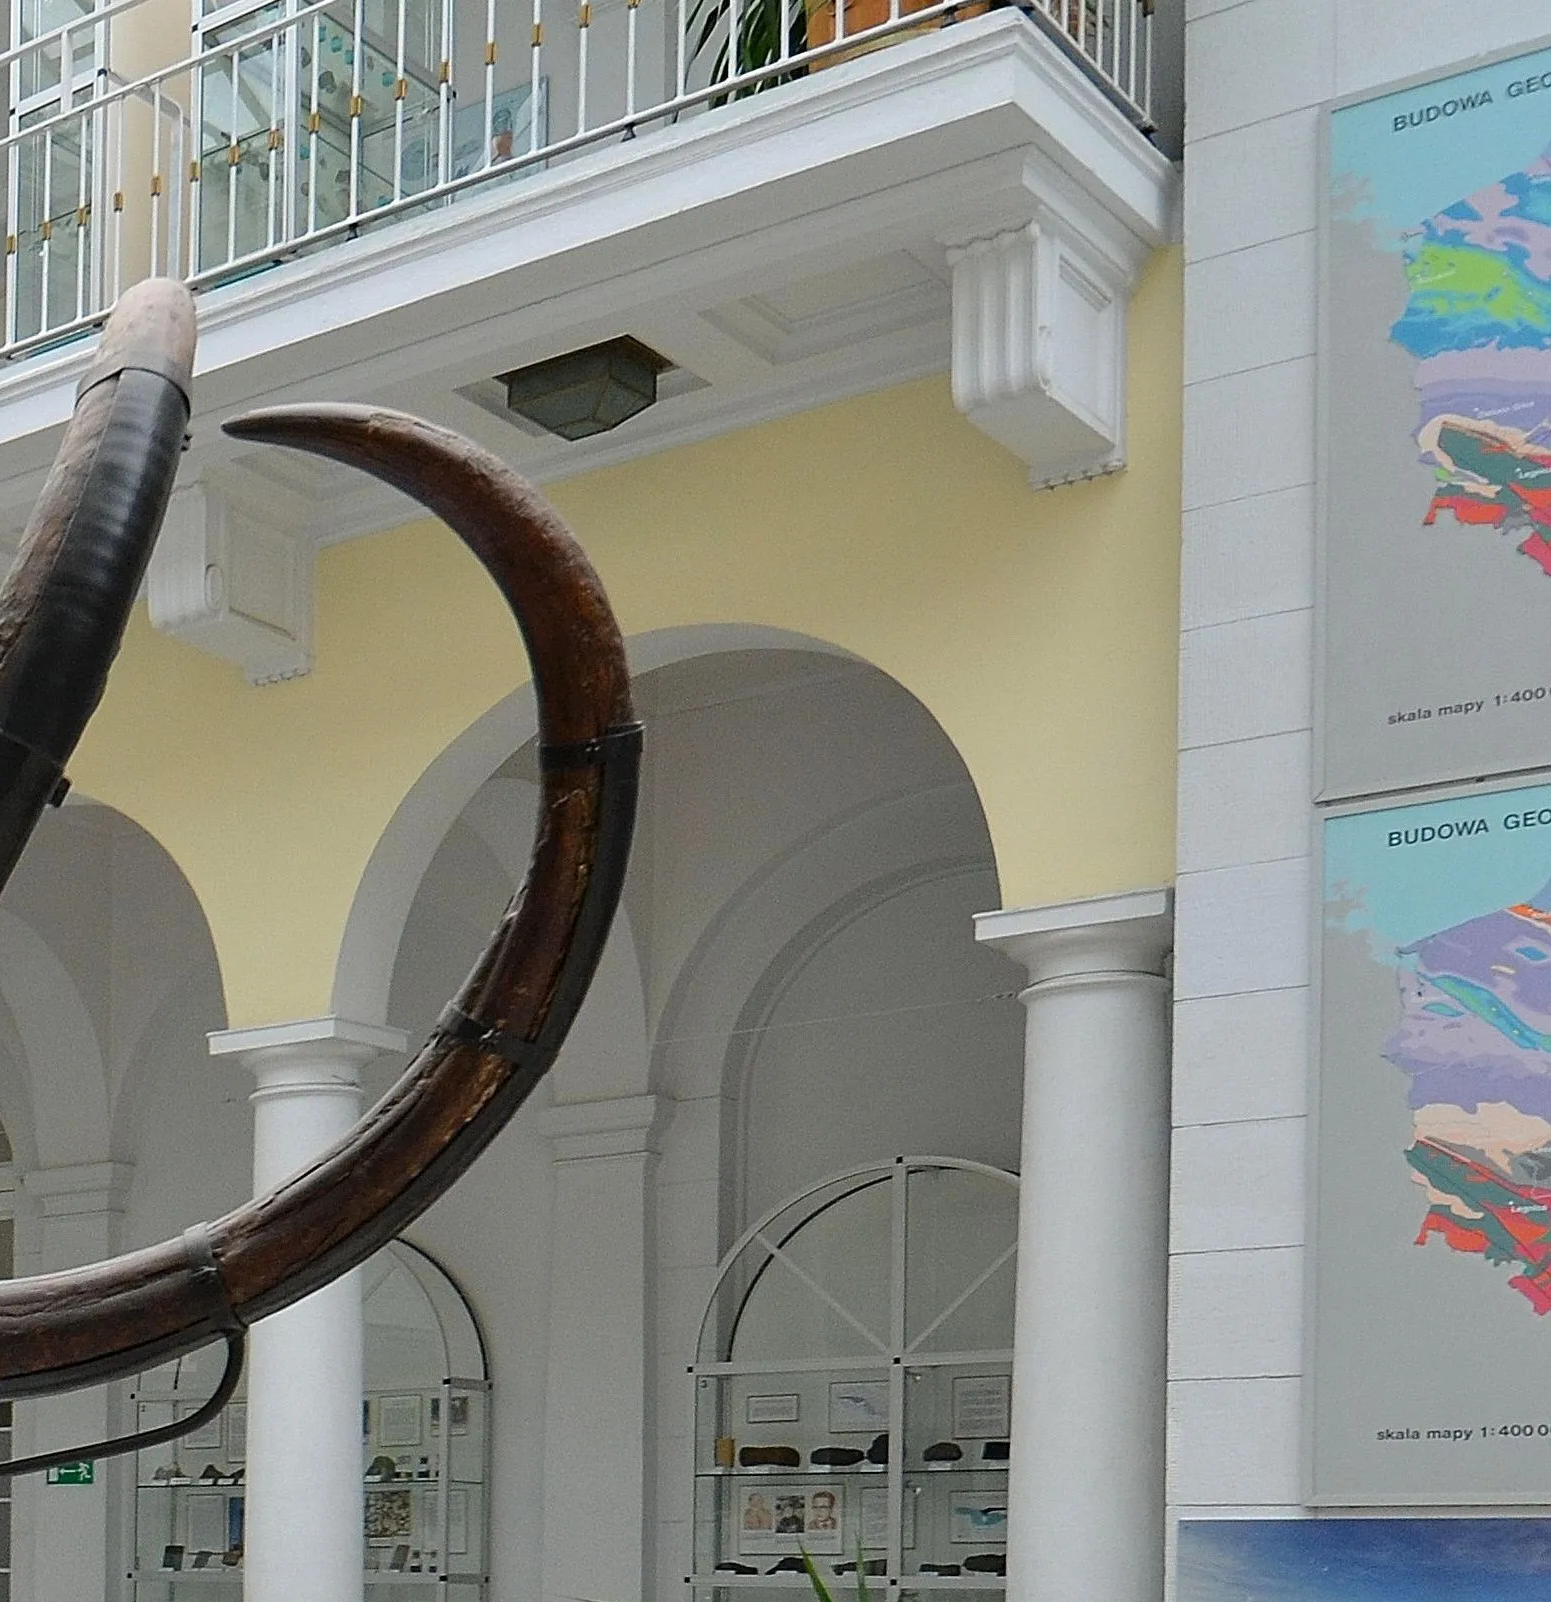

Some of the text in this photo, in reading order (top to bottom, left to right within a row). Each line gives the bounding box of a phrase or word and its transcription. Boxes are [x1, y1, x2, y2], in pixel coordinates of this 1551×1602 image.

[1393, 90, 1493, 132] BUDOWA
[1387, 707, 1432, 726] skala
[1438, 699, 1485, 717] mapy
[1387, 818, 1489, 847] BUDOWA
[1376, 1426, 1420, 1441] skala
[1427, 1427, 1473, 1443] mapy
